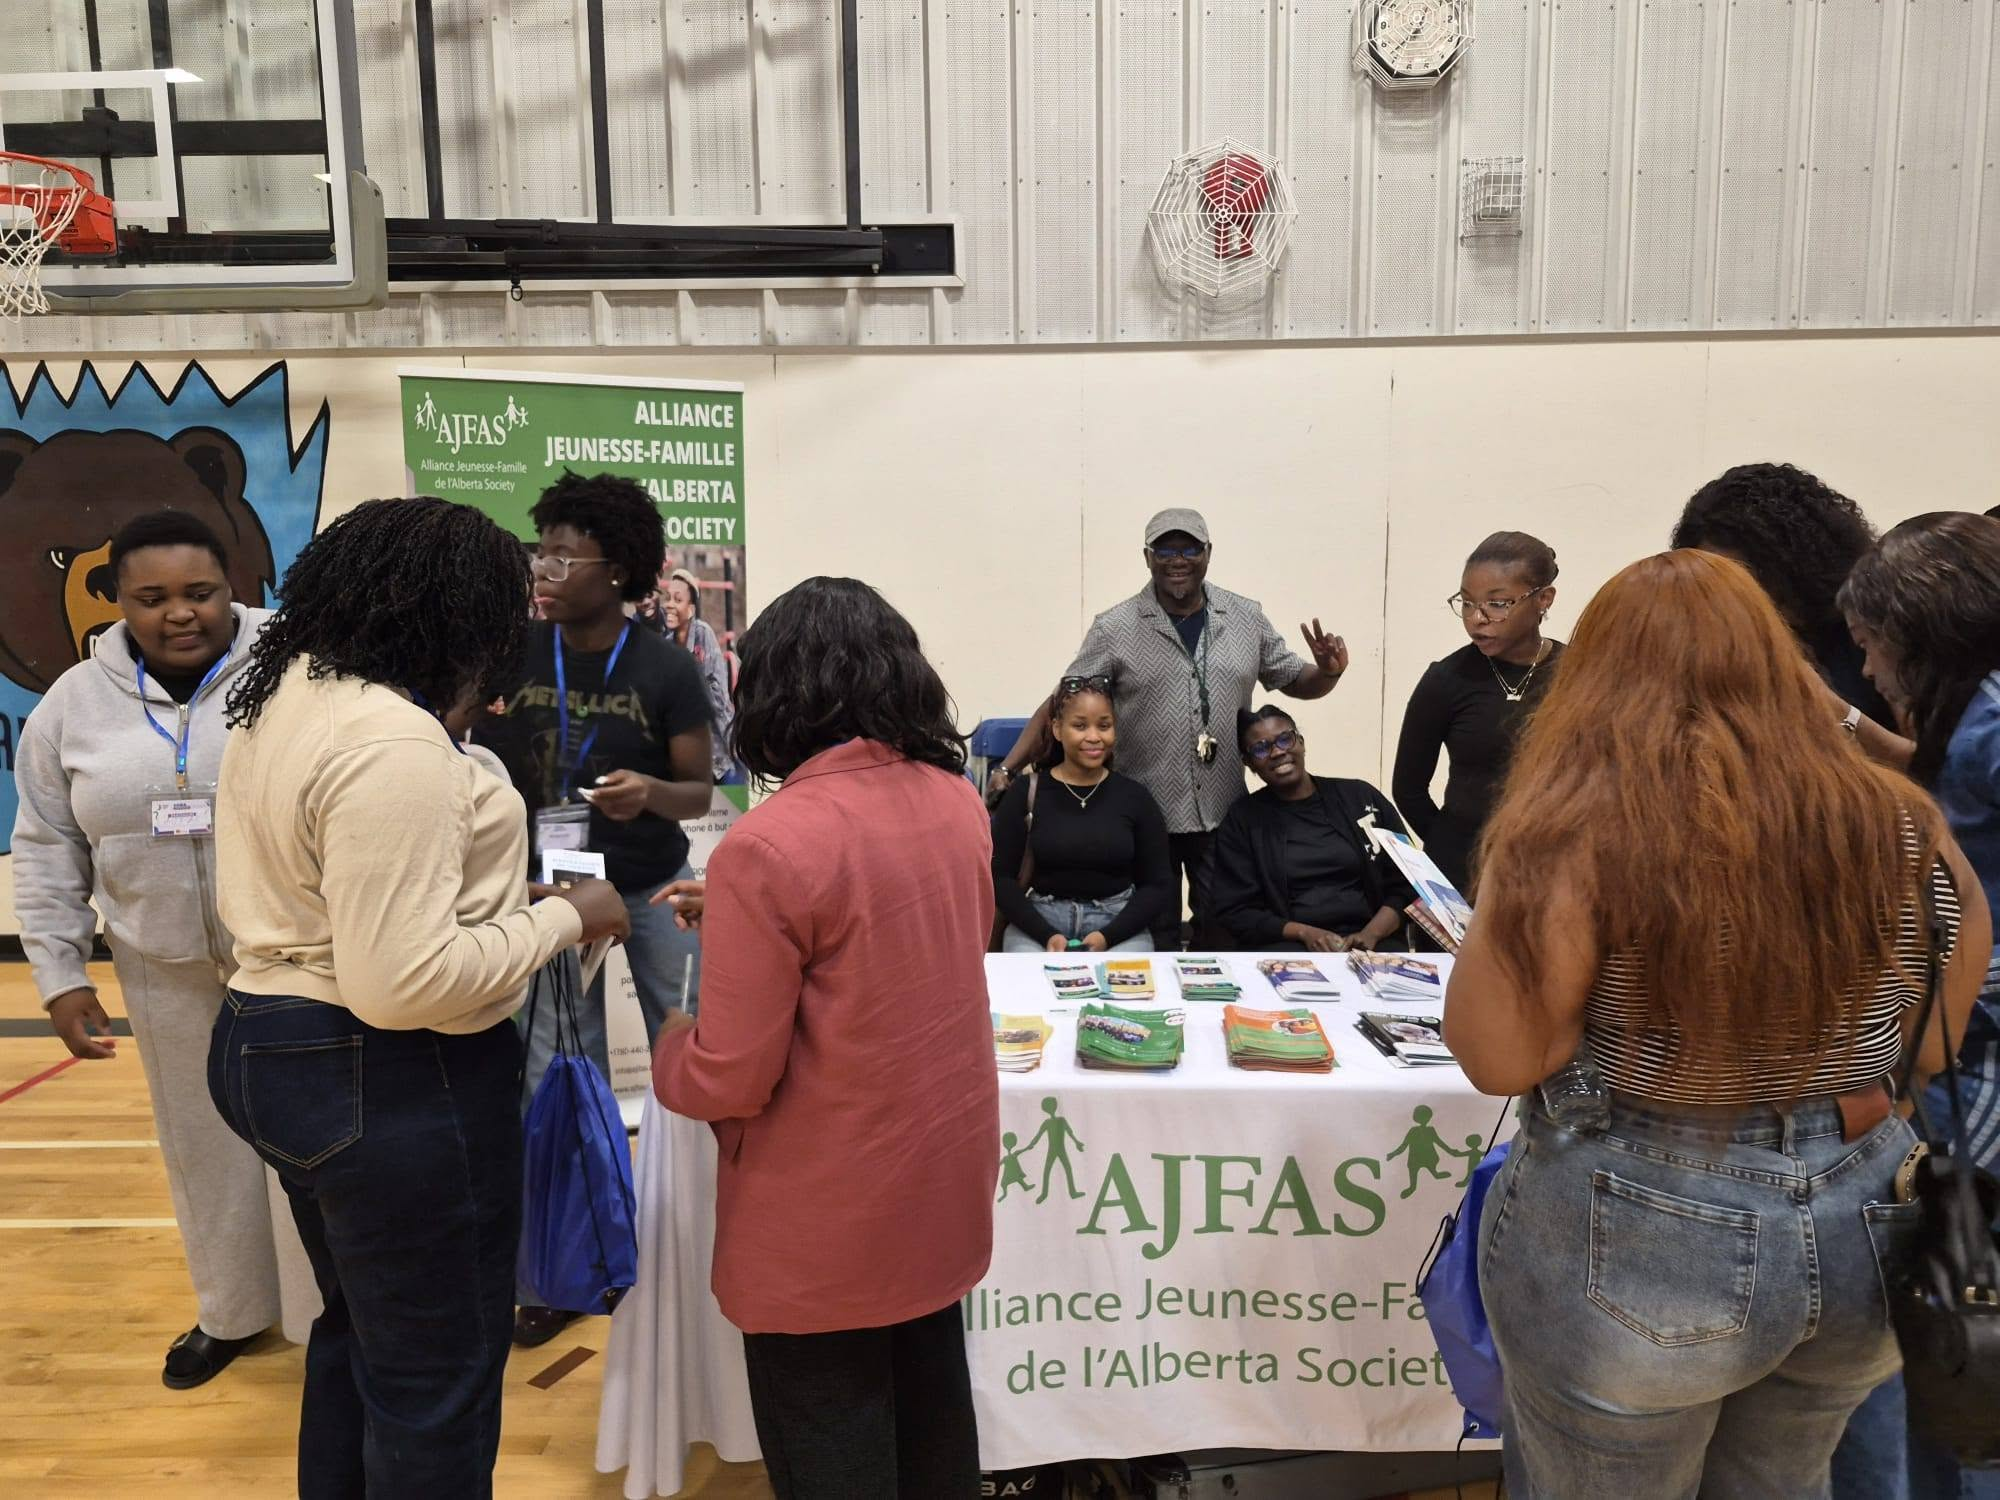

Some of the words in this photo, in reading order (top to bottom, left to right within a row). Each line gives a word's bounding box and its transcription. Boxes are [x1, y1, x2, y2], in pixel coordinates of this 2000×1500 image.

[634, 400, 734, 428] ALLIANCE
[435, 413, 507, 454] AJFAS
[544, 436, 735, 466] JEUNESSE-FAMILLE
[420, 459, 455, 472] Alliance
[456, 460, 528, 473] Jeunesse-Famille
[434, 478, 446, 489] de
[448, 478, 483, 490] l'Alberta
[484, 479, 515, 492] Society
[641, 478, 737, 504] 'ALBERTA
[664, 516, 737, 540] OCIETY
[1076, 1152, 1386, 1260] AJFAS
[964, 1287, 1122, 1332] lliance
[1135, 1278, 1428, 1322] Jeunesse-Fa
[1006, 1349, 1067, 1395] de
[1084, 1341, 1279, 1389] l'Alberta
[1296, 1347, 1449, 1388] Societ
